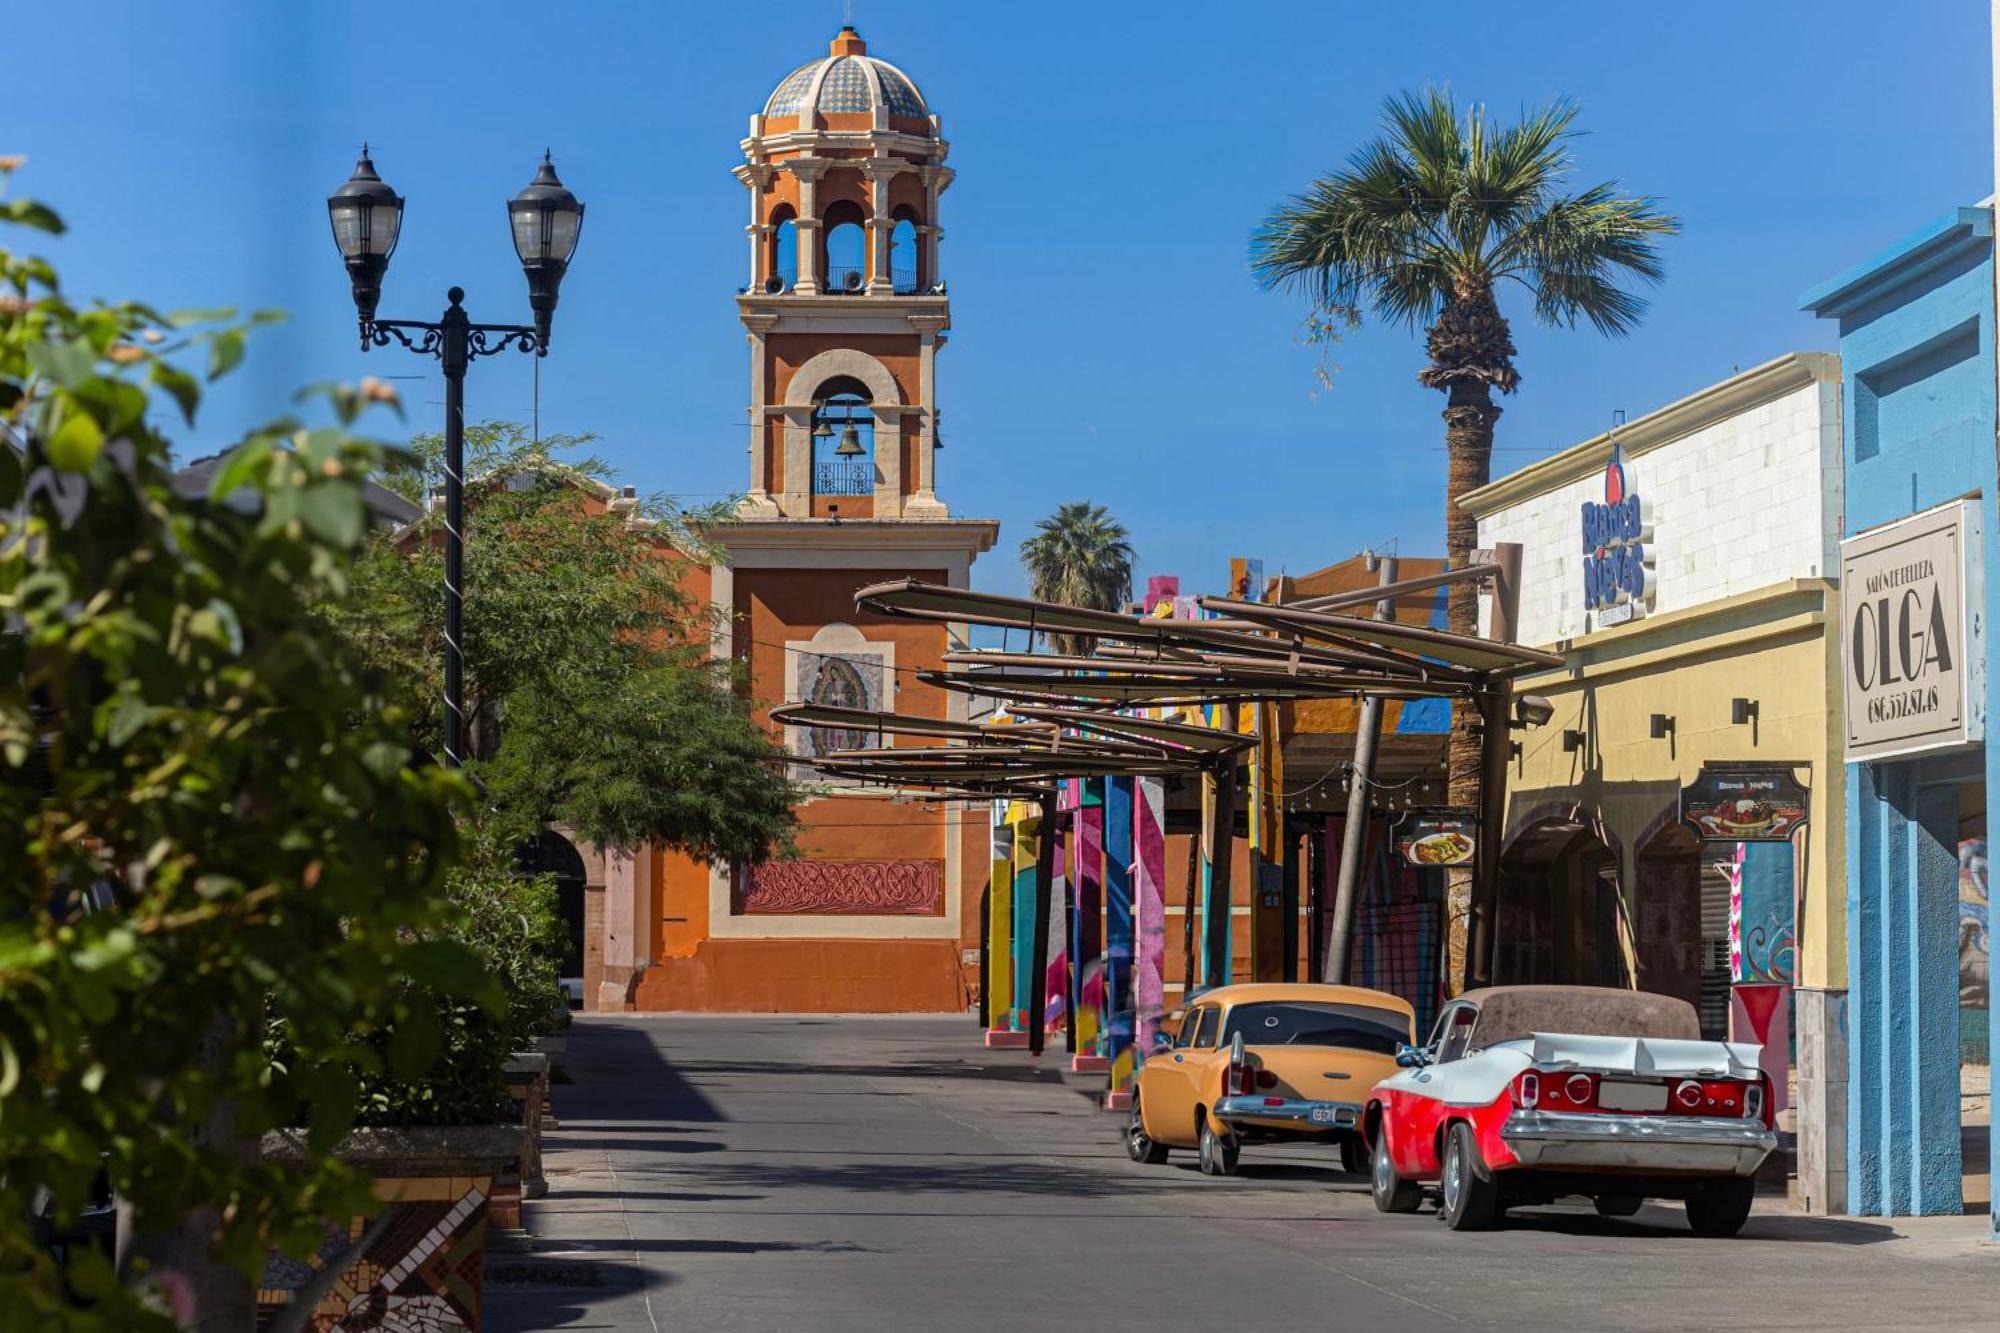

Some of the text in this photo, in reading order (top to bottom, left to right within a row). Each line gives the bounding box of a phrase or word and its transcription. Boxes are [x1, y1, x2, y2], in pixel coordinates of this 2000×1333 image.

[1890, 568, 1900, 589] DE
[1901, 559, 1934, 585] BELLEZA
[1852, 581, 1953, 692] OLGA
